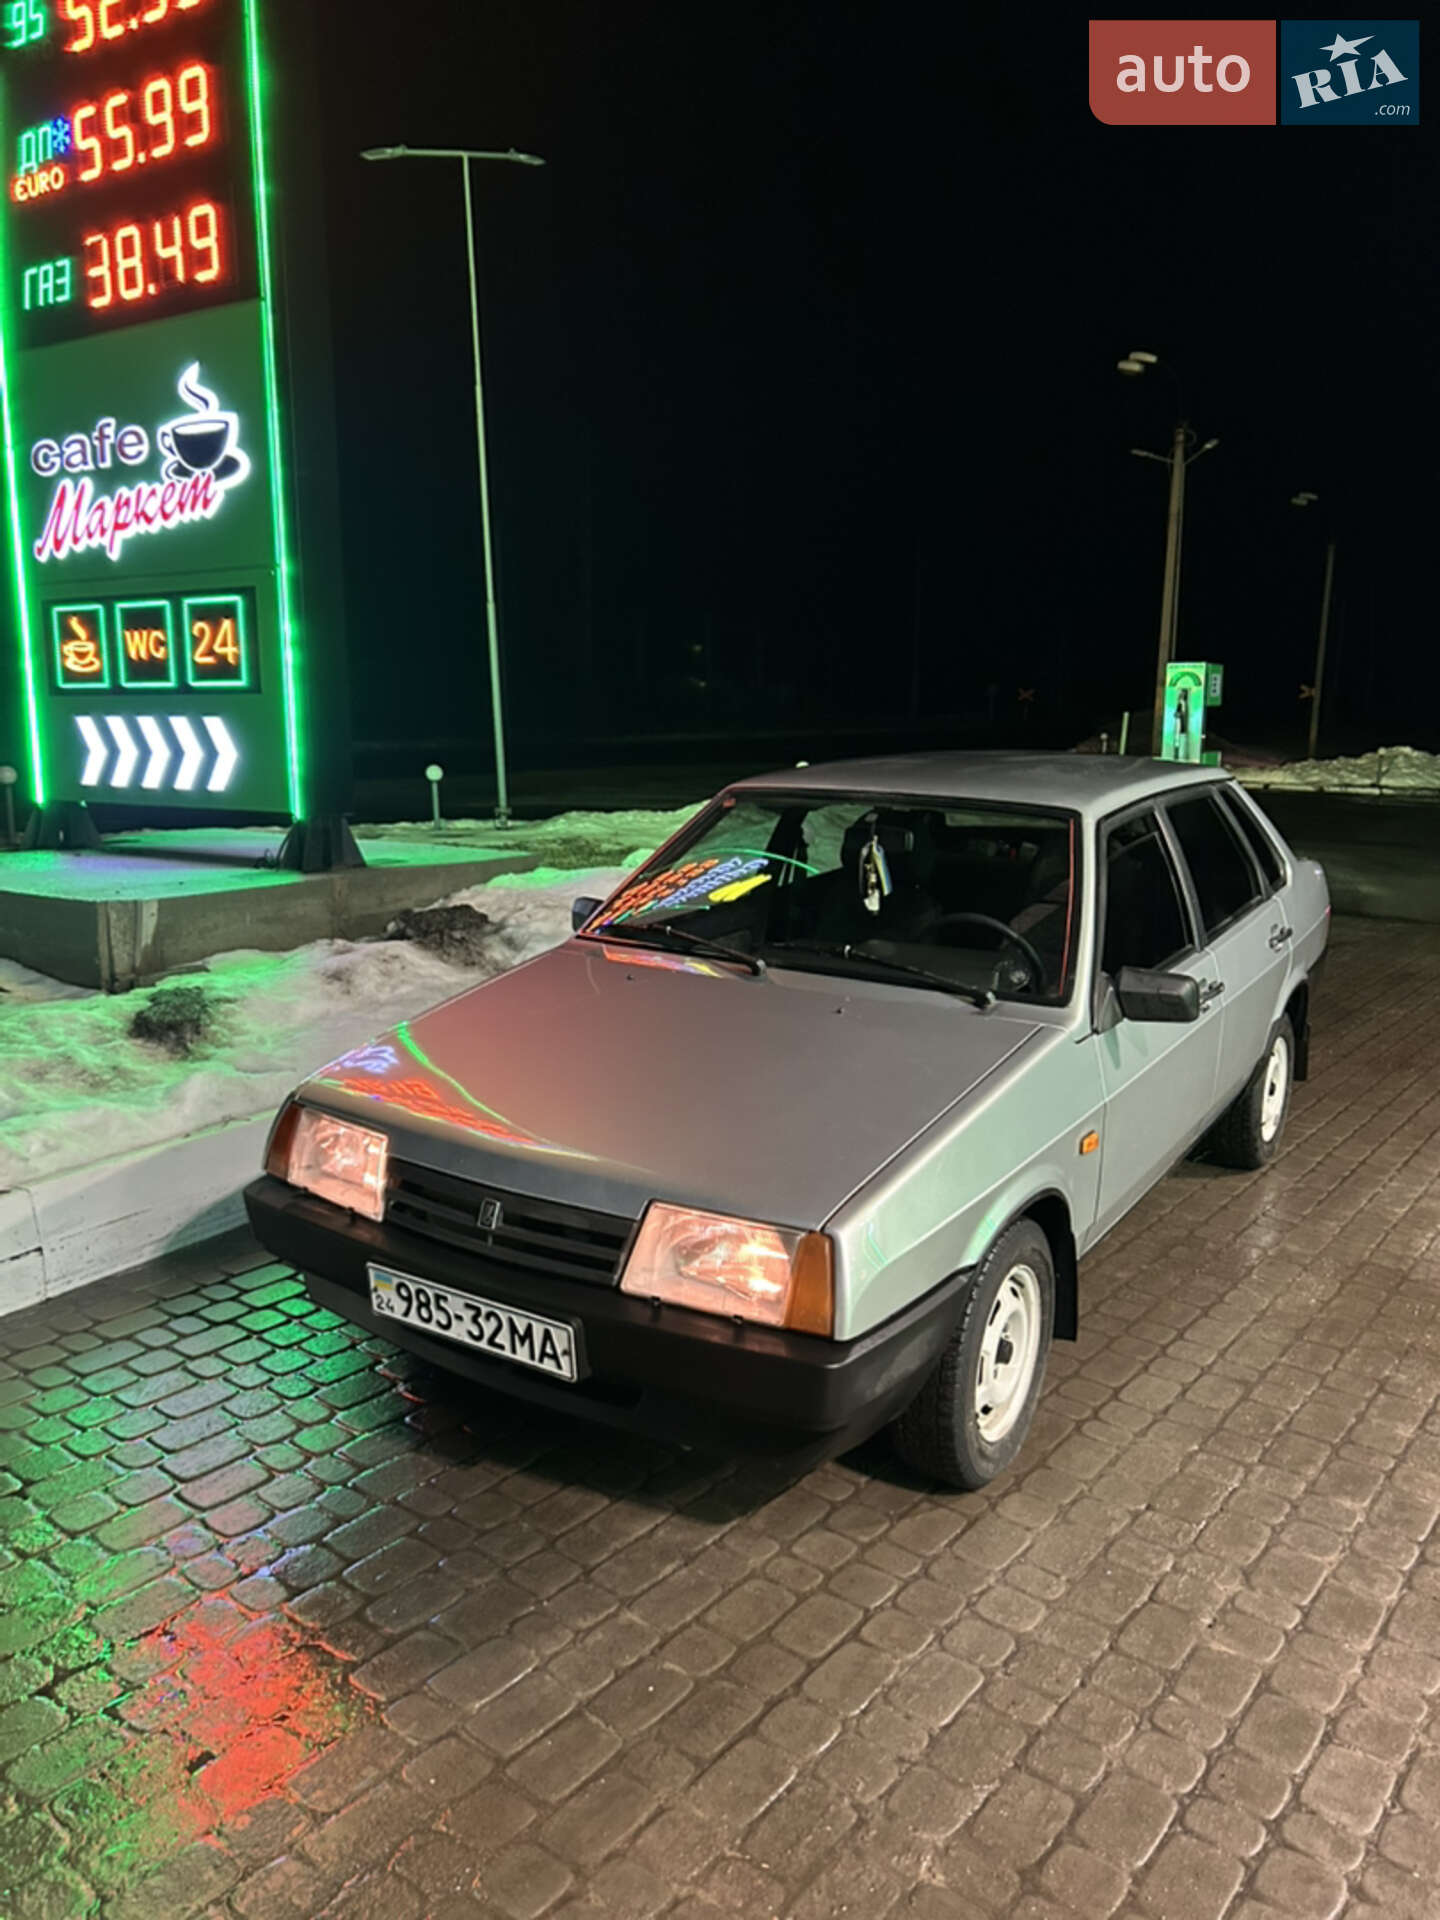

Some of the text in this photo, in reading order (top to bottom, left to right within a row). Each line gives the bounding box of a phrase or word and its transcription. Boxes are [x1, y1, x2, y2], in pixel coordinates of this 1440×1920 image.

[10, 0, 201, 52] 95 52.
[73, 65, 209, 181] 55.99
[23, 203, 220, 309] ГАЗ 38.49
[32, 419, 148, 475] cafe
[35, 472, 218, 556] Маркет
[124, 629, 168, 661] WC
[191, 618, 239, 665] 24
[376, 1294, 394, 1313] 24
